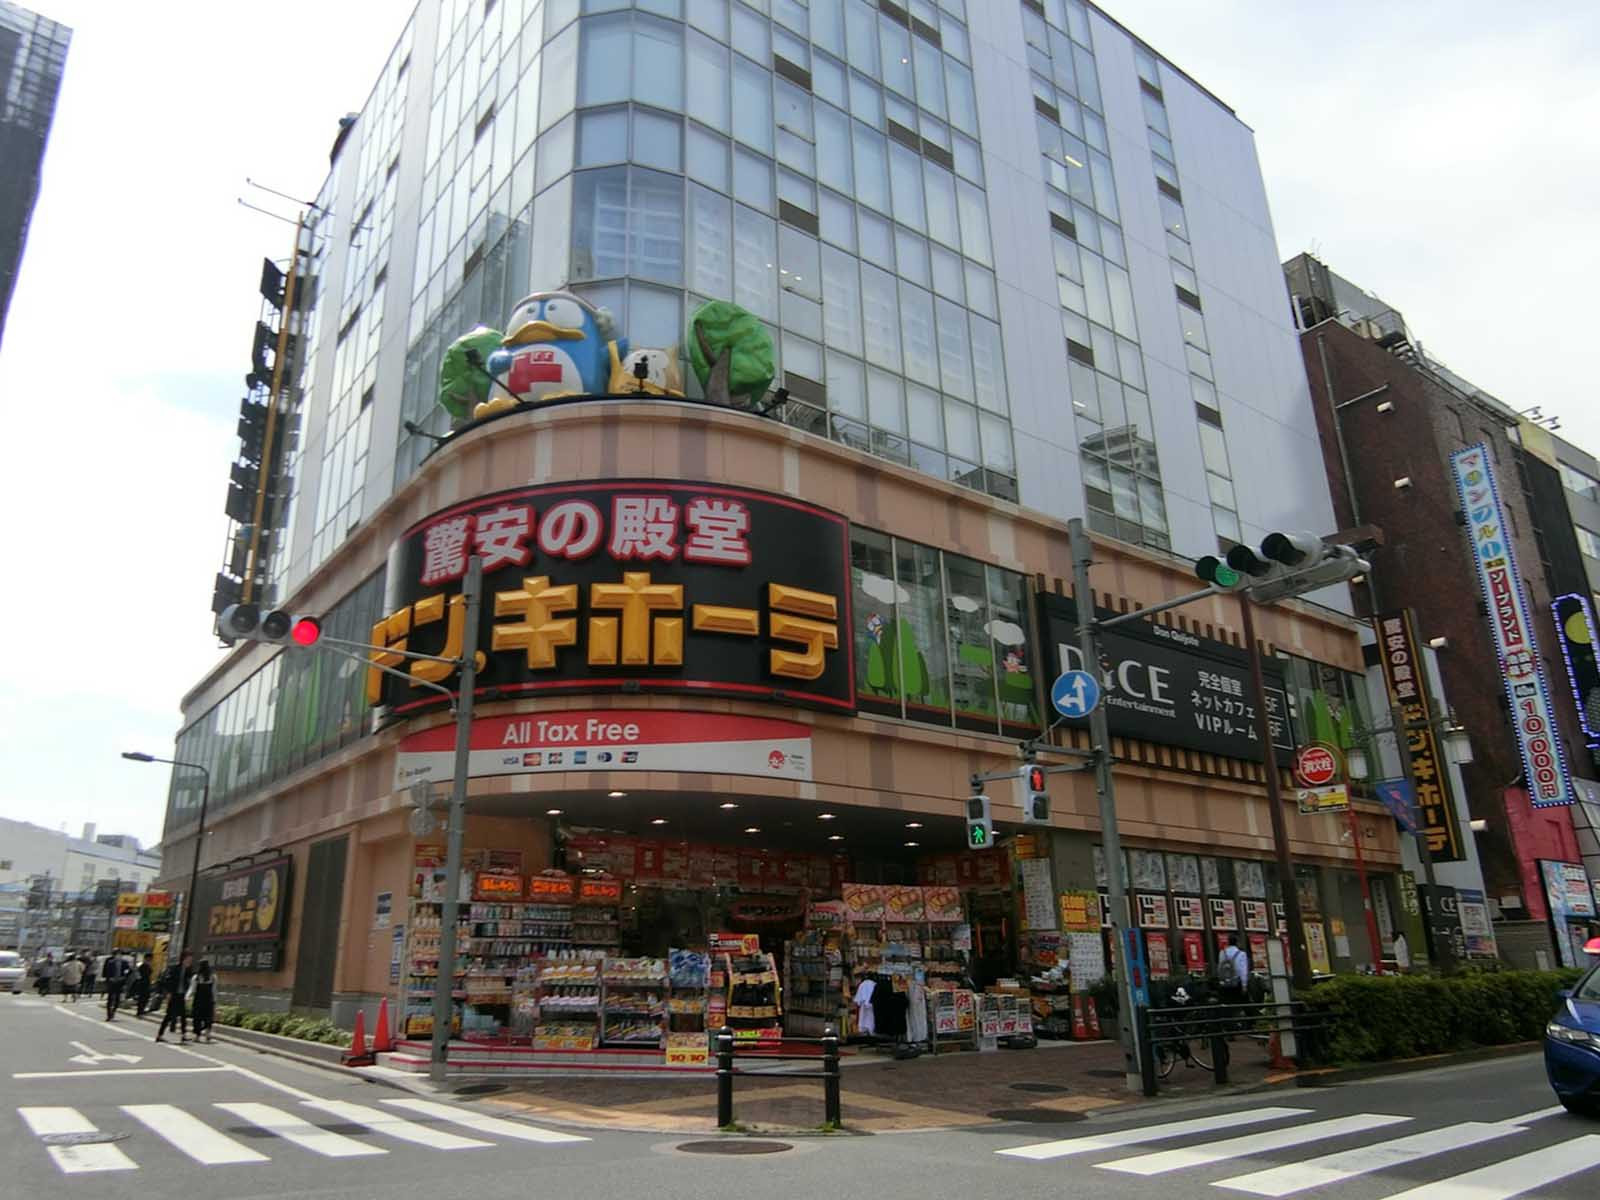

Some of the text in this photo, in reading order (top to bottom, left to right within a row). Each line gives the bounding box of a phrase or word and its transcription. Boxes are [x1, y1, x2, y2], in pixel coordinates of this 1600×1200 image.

[420, 495, 752, 585] 驚安の殿堂
[1197, 670, 1243, 697] 完全個室
[1191, 689, 1256, 719] ネットカフェ
[501, 717, 641, 745] All Tax Free
[1193, 711, 1258, 741] VIPルーム
